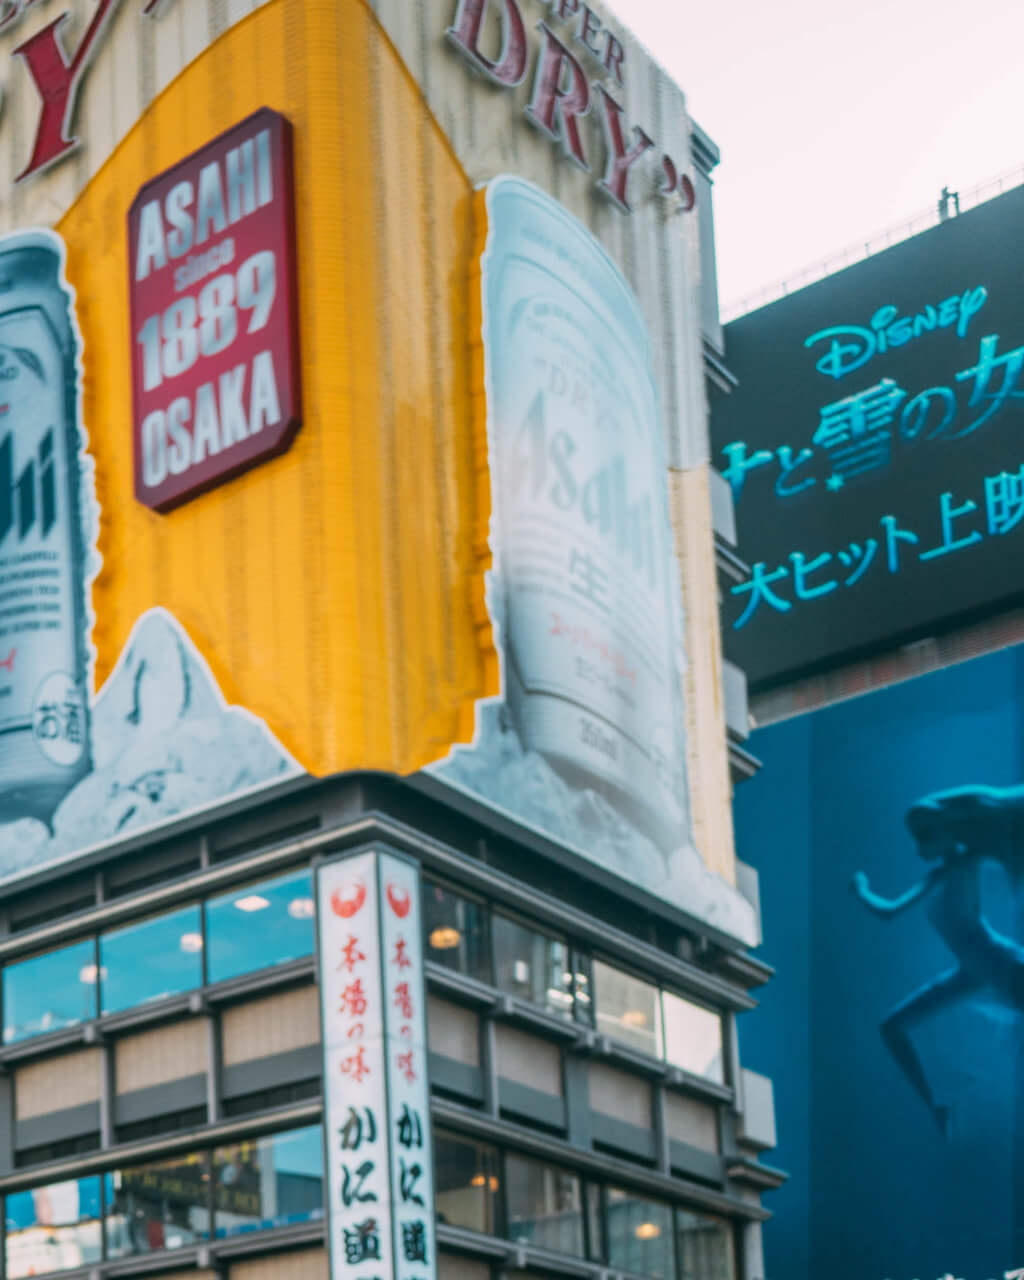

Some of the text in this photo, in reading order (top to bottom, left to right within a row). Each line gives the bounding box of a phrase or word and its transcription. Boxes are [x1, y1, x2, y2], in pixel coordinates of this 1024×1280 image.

[135, 130, 272, 281] ASAHI
[175, 238, 235, 291] since
[138, 251, 276, 391] 1889
[142, 350, 280, 487] OSAKA
[508, 390, 658, 590] Asahi
